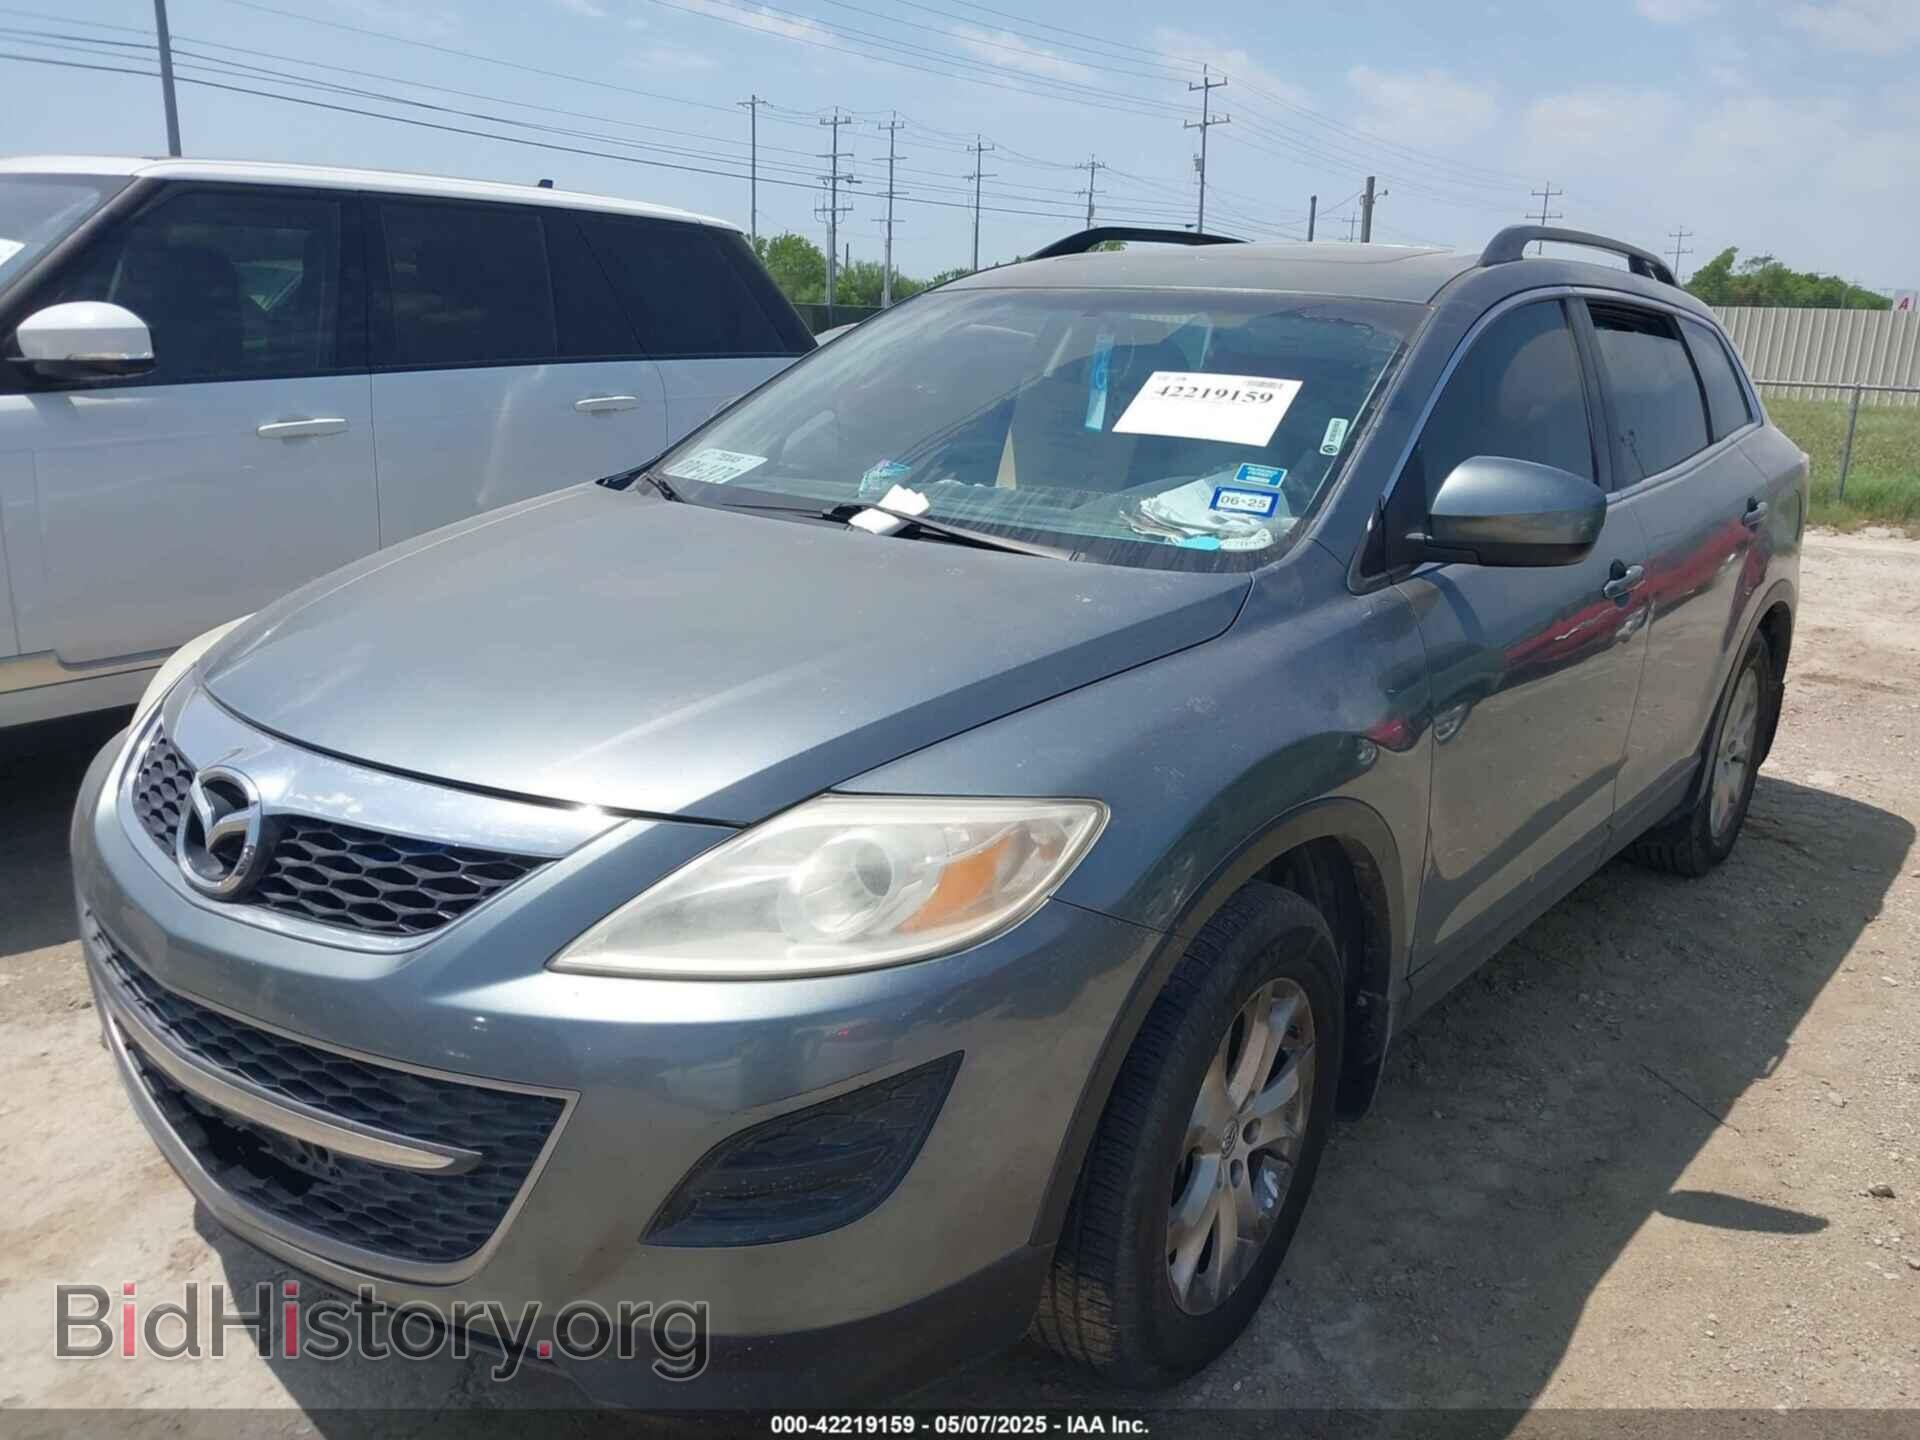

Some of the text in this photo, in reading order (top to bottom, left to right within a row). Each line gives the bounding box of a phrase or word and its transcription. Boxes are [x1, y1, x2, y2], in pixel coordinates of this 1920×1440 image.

[1898, 297, 1910, 310] A
[1154, 384, 1274, 404] 42219159
[1220, 495, 1268, 509] 06-25
